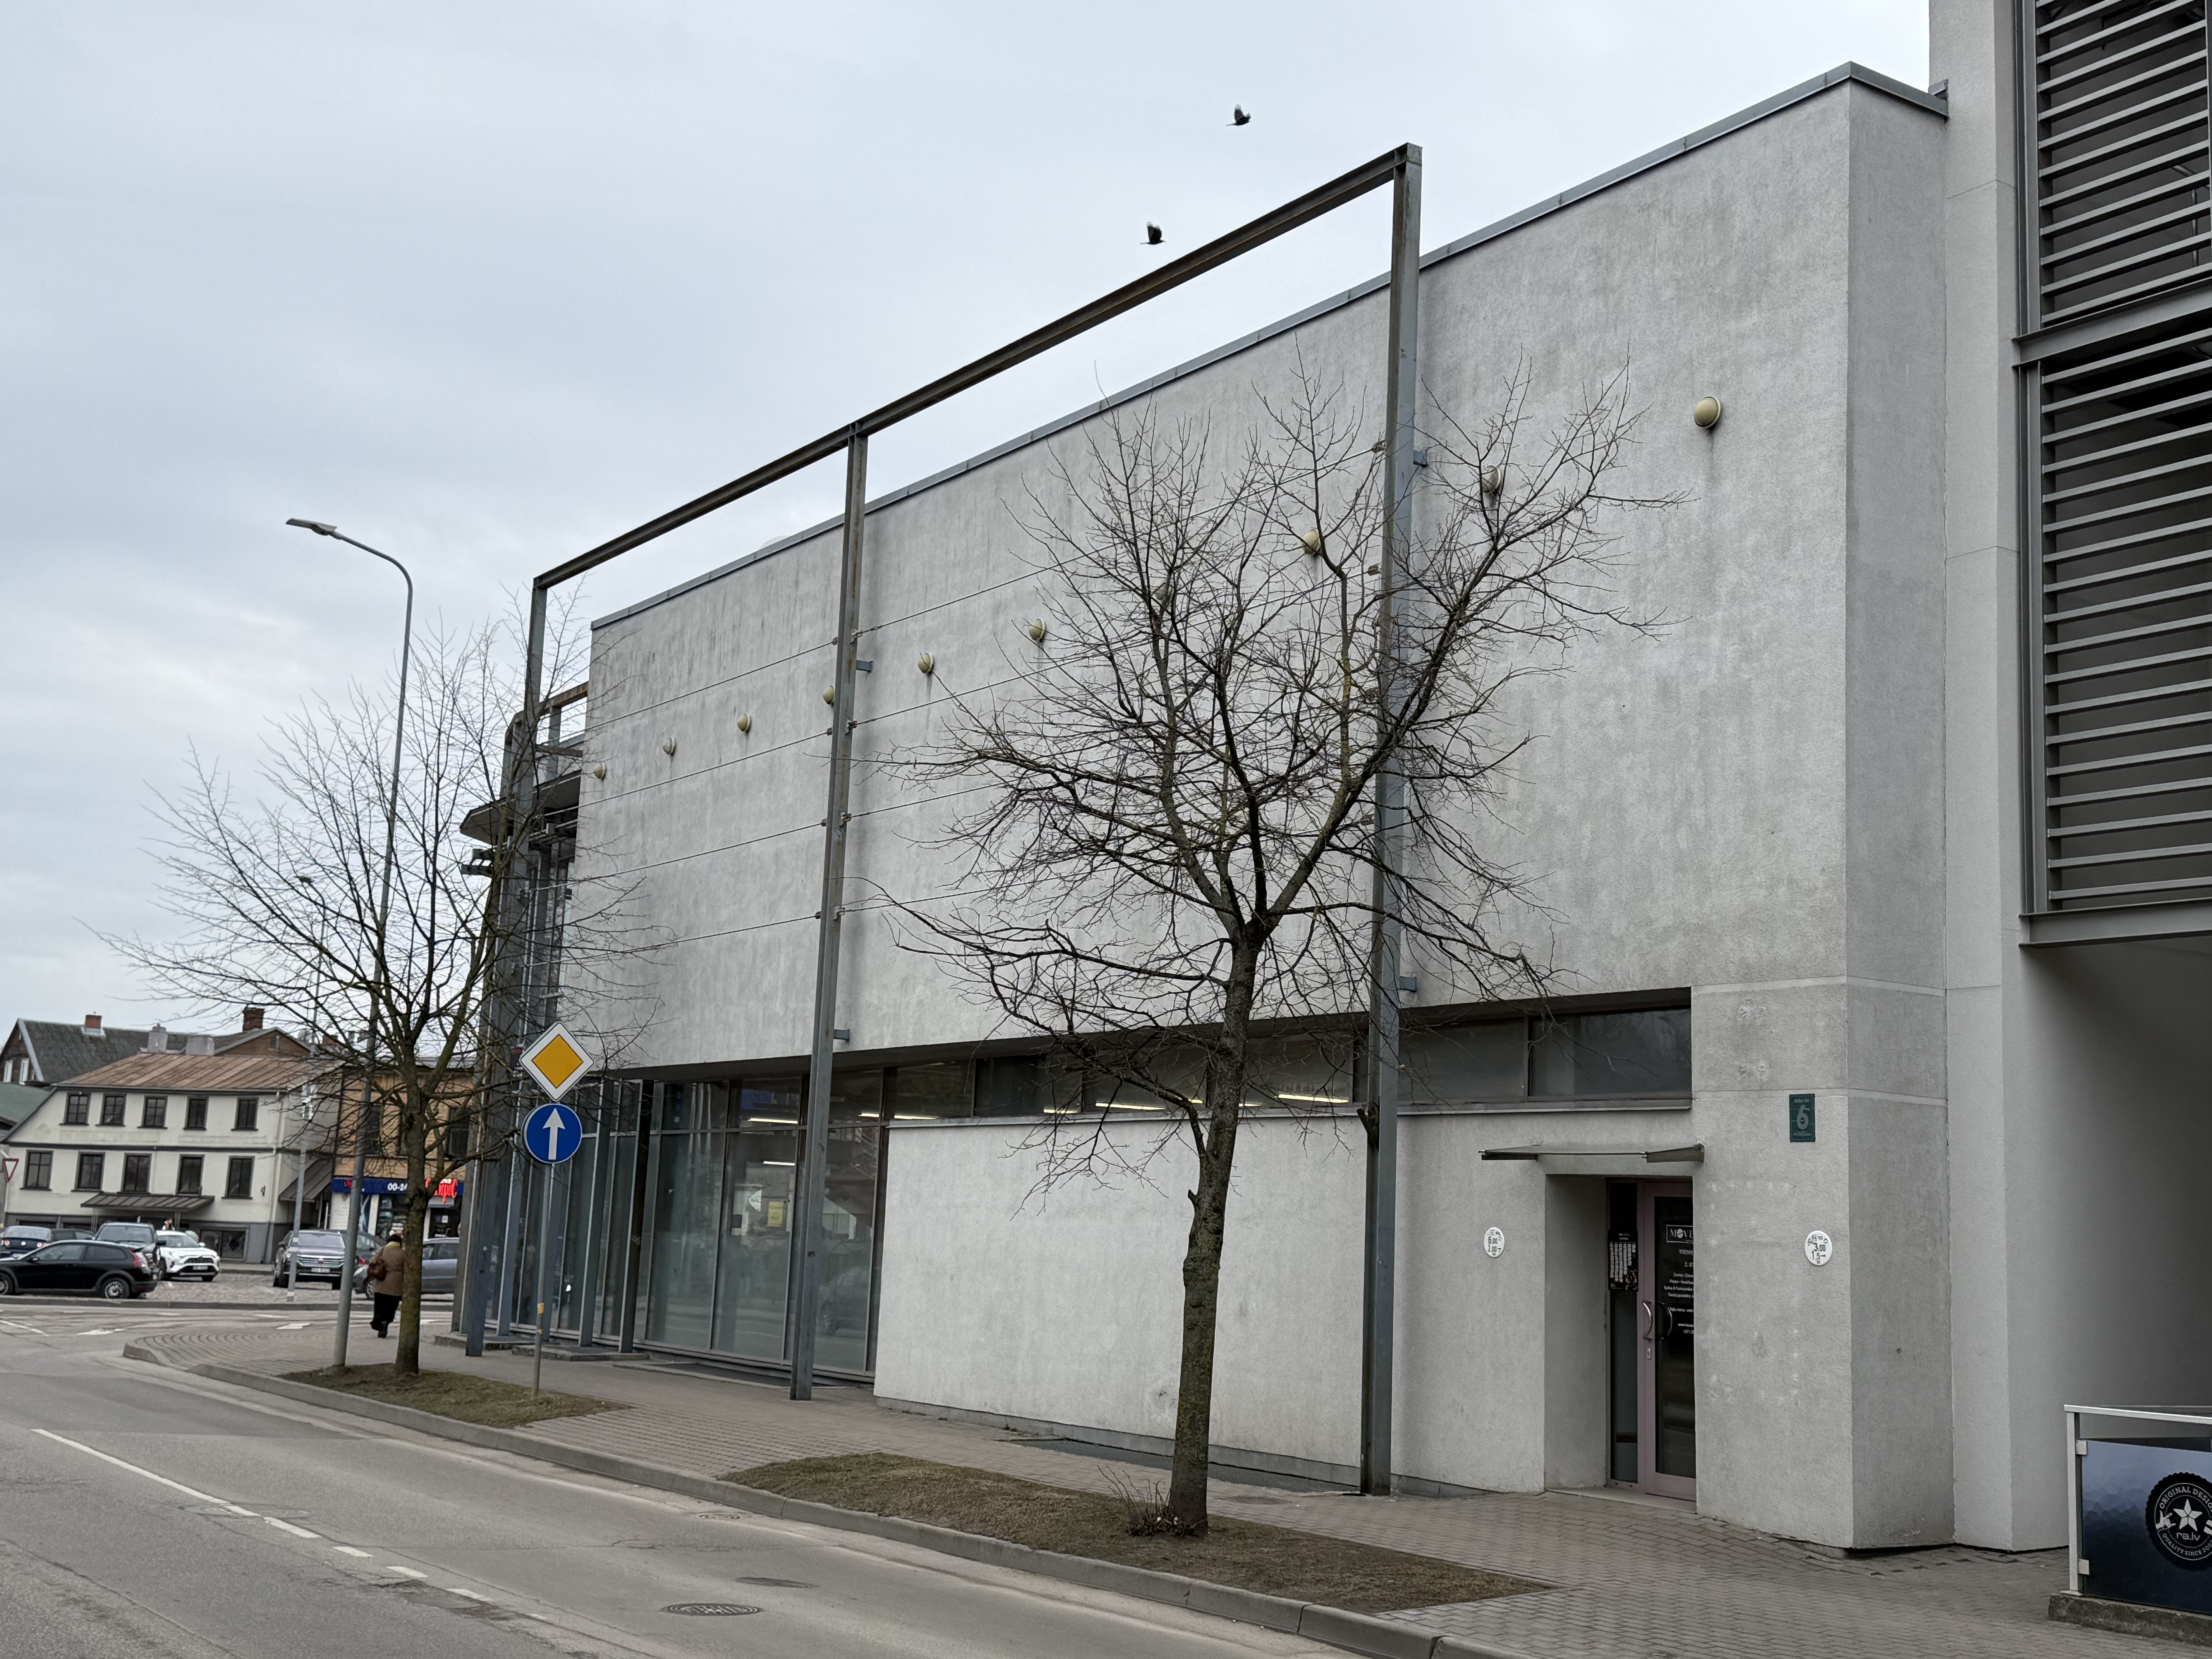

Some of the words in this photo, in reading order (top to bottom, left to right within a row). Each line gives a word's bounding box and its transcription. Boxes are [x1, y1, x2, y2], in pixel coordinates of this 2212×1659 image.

[1797, 1105, 1809, 1129] 6
[2159, 1486, 2191, 1509] ORIGINAL
[2193, 1488, 2212, 1512] DESIG
[2162, 1533, 2185, 1554] QUALITY
[2176, 1532, 2200, 1541] ra.lv
